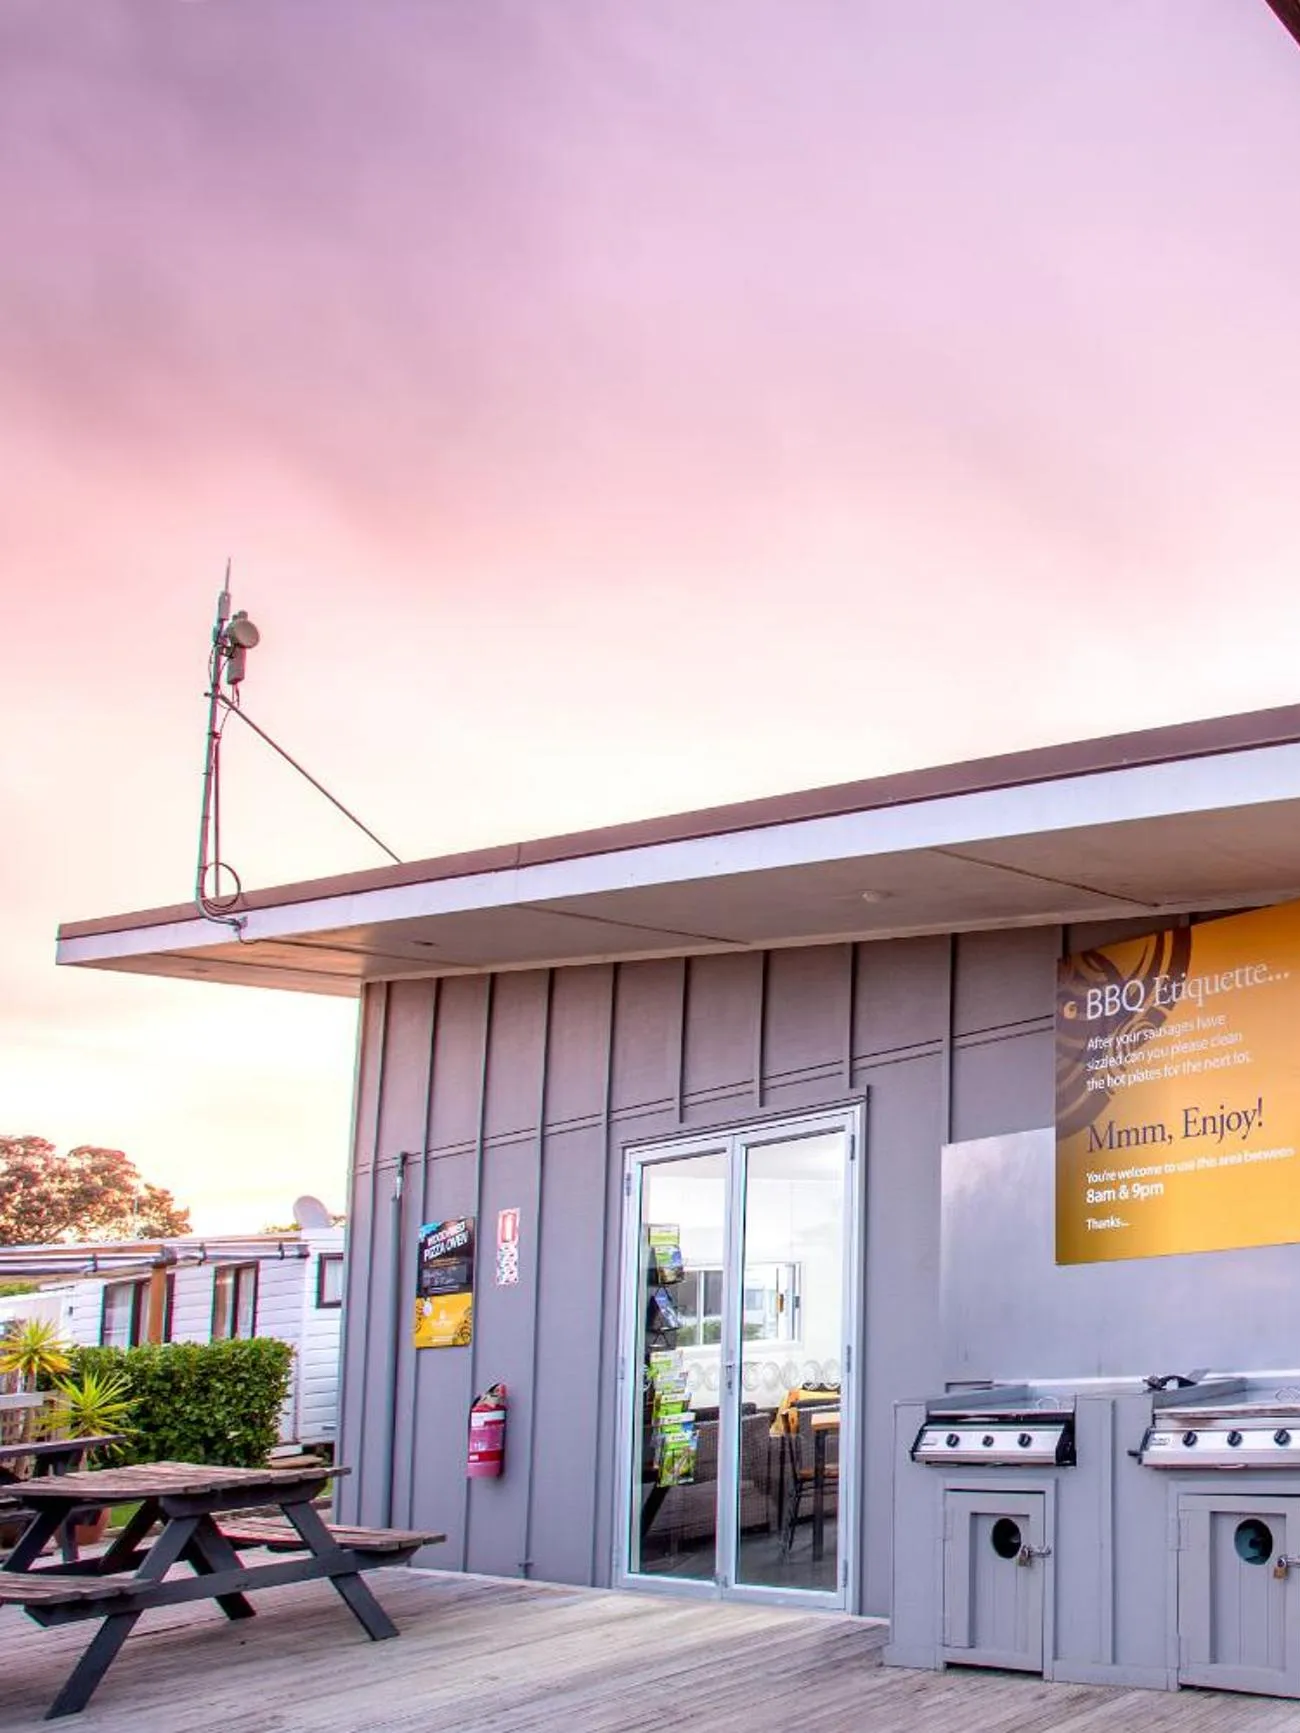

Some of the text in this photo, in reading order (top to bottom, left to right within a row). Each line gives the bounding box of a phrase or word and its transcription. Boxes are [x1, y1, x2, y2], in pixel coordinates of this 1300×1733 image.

[1086, 979, 1145, 1020] BBQ
[1088, 1013, 1226, 1050] After your sausages have
[1086, 1031, 1243, 1071] sizzled can you please clean
[1086, 1074, 1104, 1091] the
[1107, 1071, 1126, 1088] hot
[1128, 1066, 1162, 1088] plates
[1163, 1062, 1181, 1077] for
[1182, 1058, 1203, 1074] the
[1203, 1053, 1231, 1070] next
[1088, 1097, 1263, 1153] Mmm, Enjoy!
[1086, 1147, 1295, 1184] You're welcome to use this area between
[1086, 1181, 1164, 1204] 8am & 9pm
